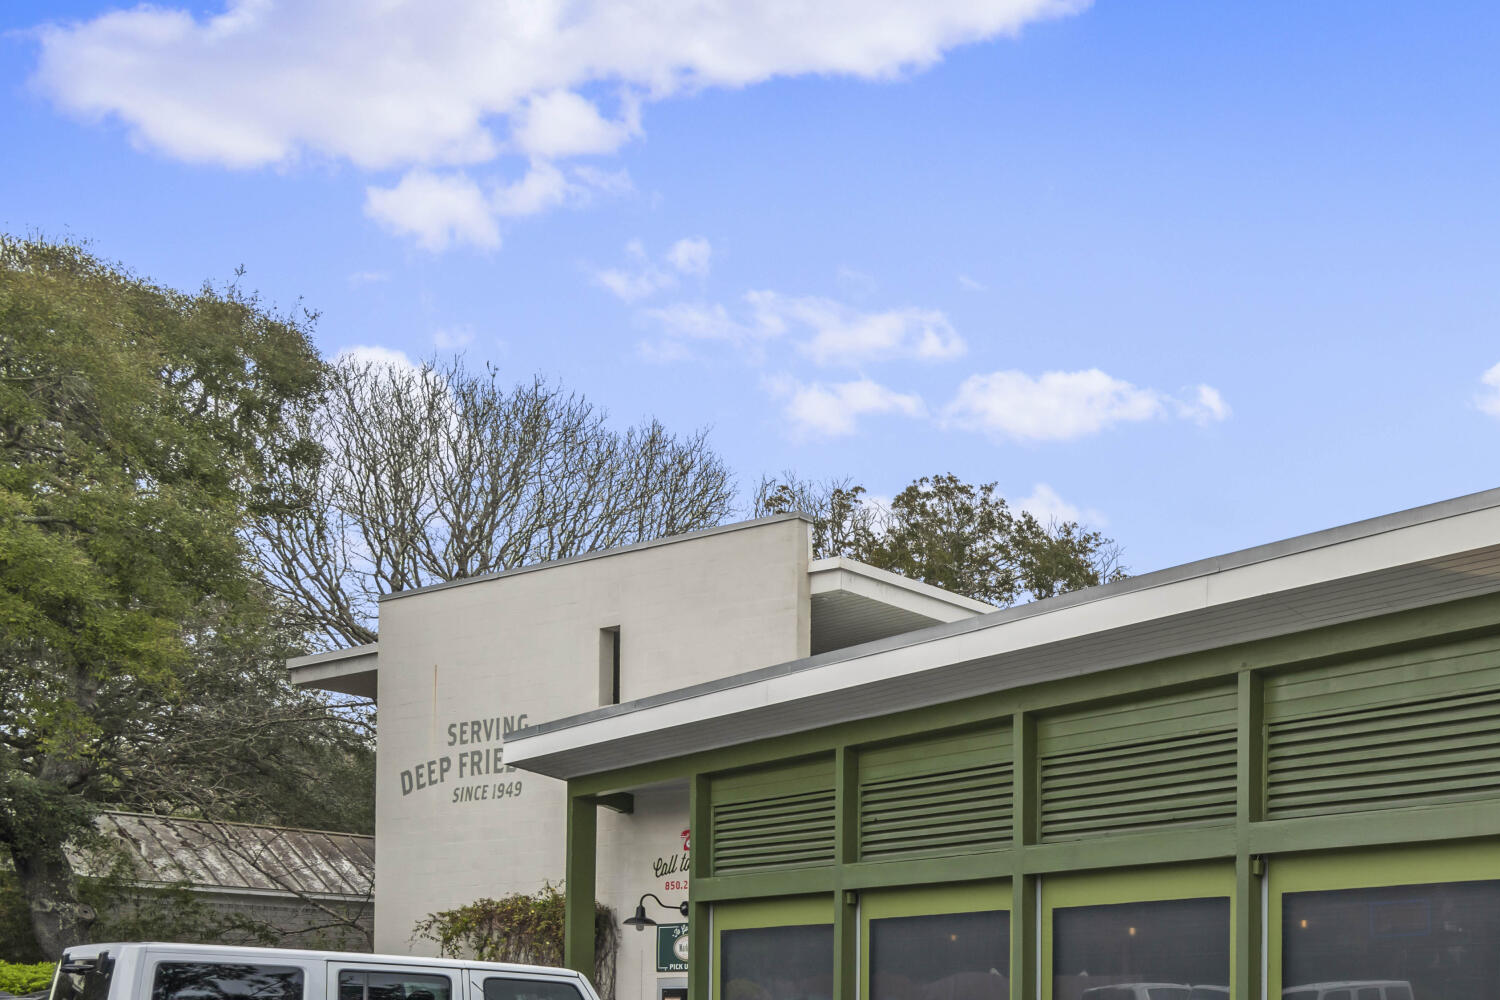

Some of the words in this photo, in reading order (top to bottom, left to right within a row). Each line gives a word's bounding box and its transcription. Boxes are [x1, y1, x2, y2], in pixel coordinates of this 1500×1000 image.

[447, 713, 528, 747] SERVING
[400, 756, 452, 797] DEEP
[452, 784, 489, 804] SINCE
[491, 780, 523, 800] 1949
[653, 854, 678, 879] Call
[665, 881, 688, 890] 850.2
